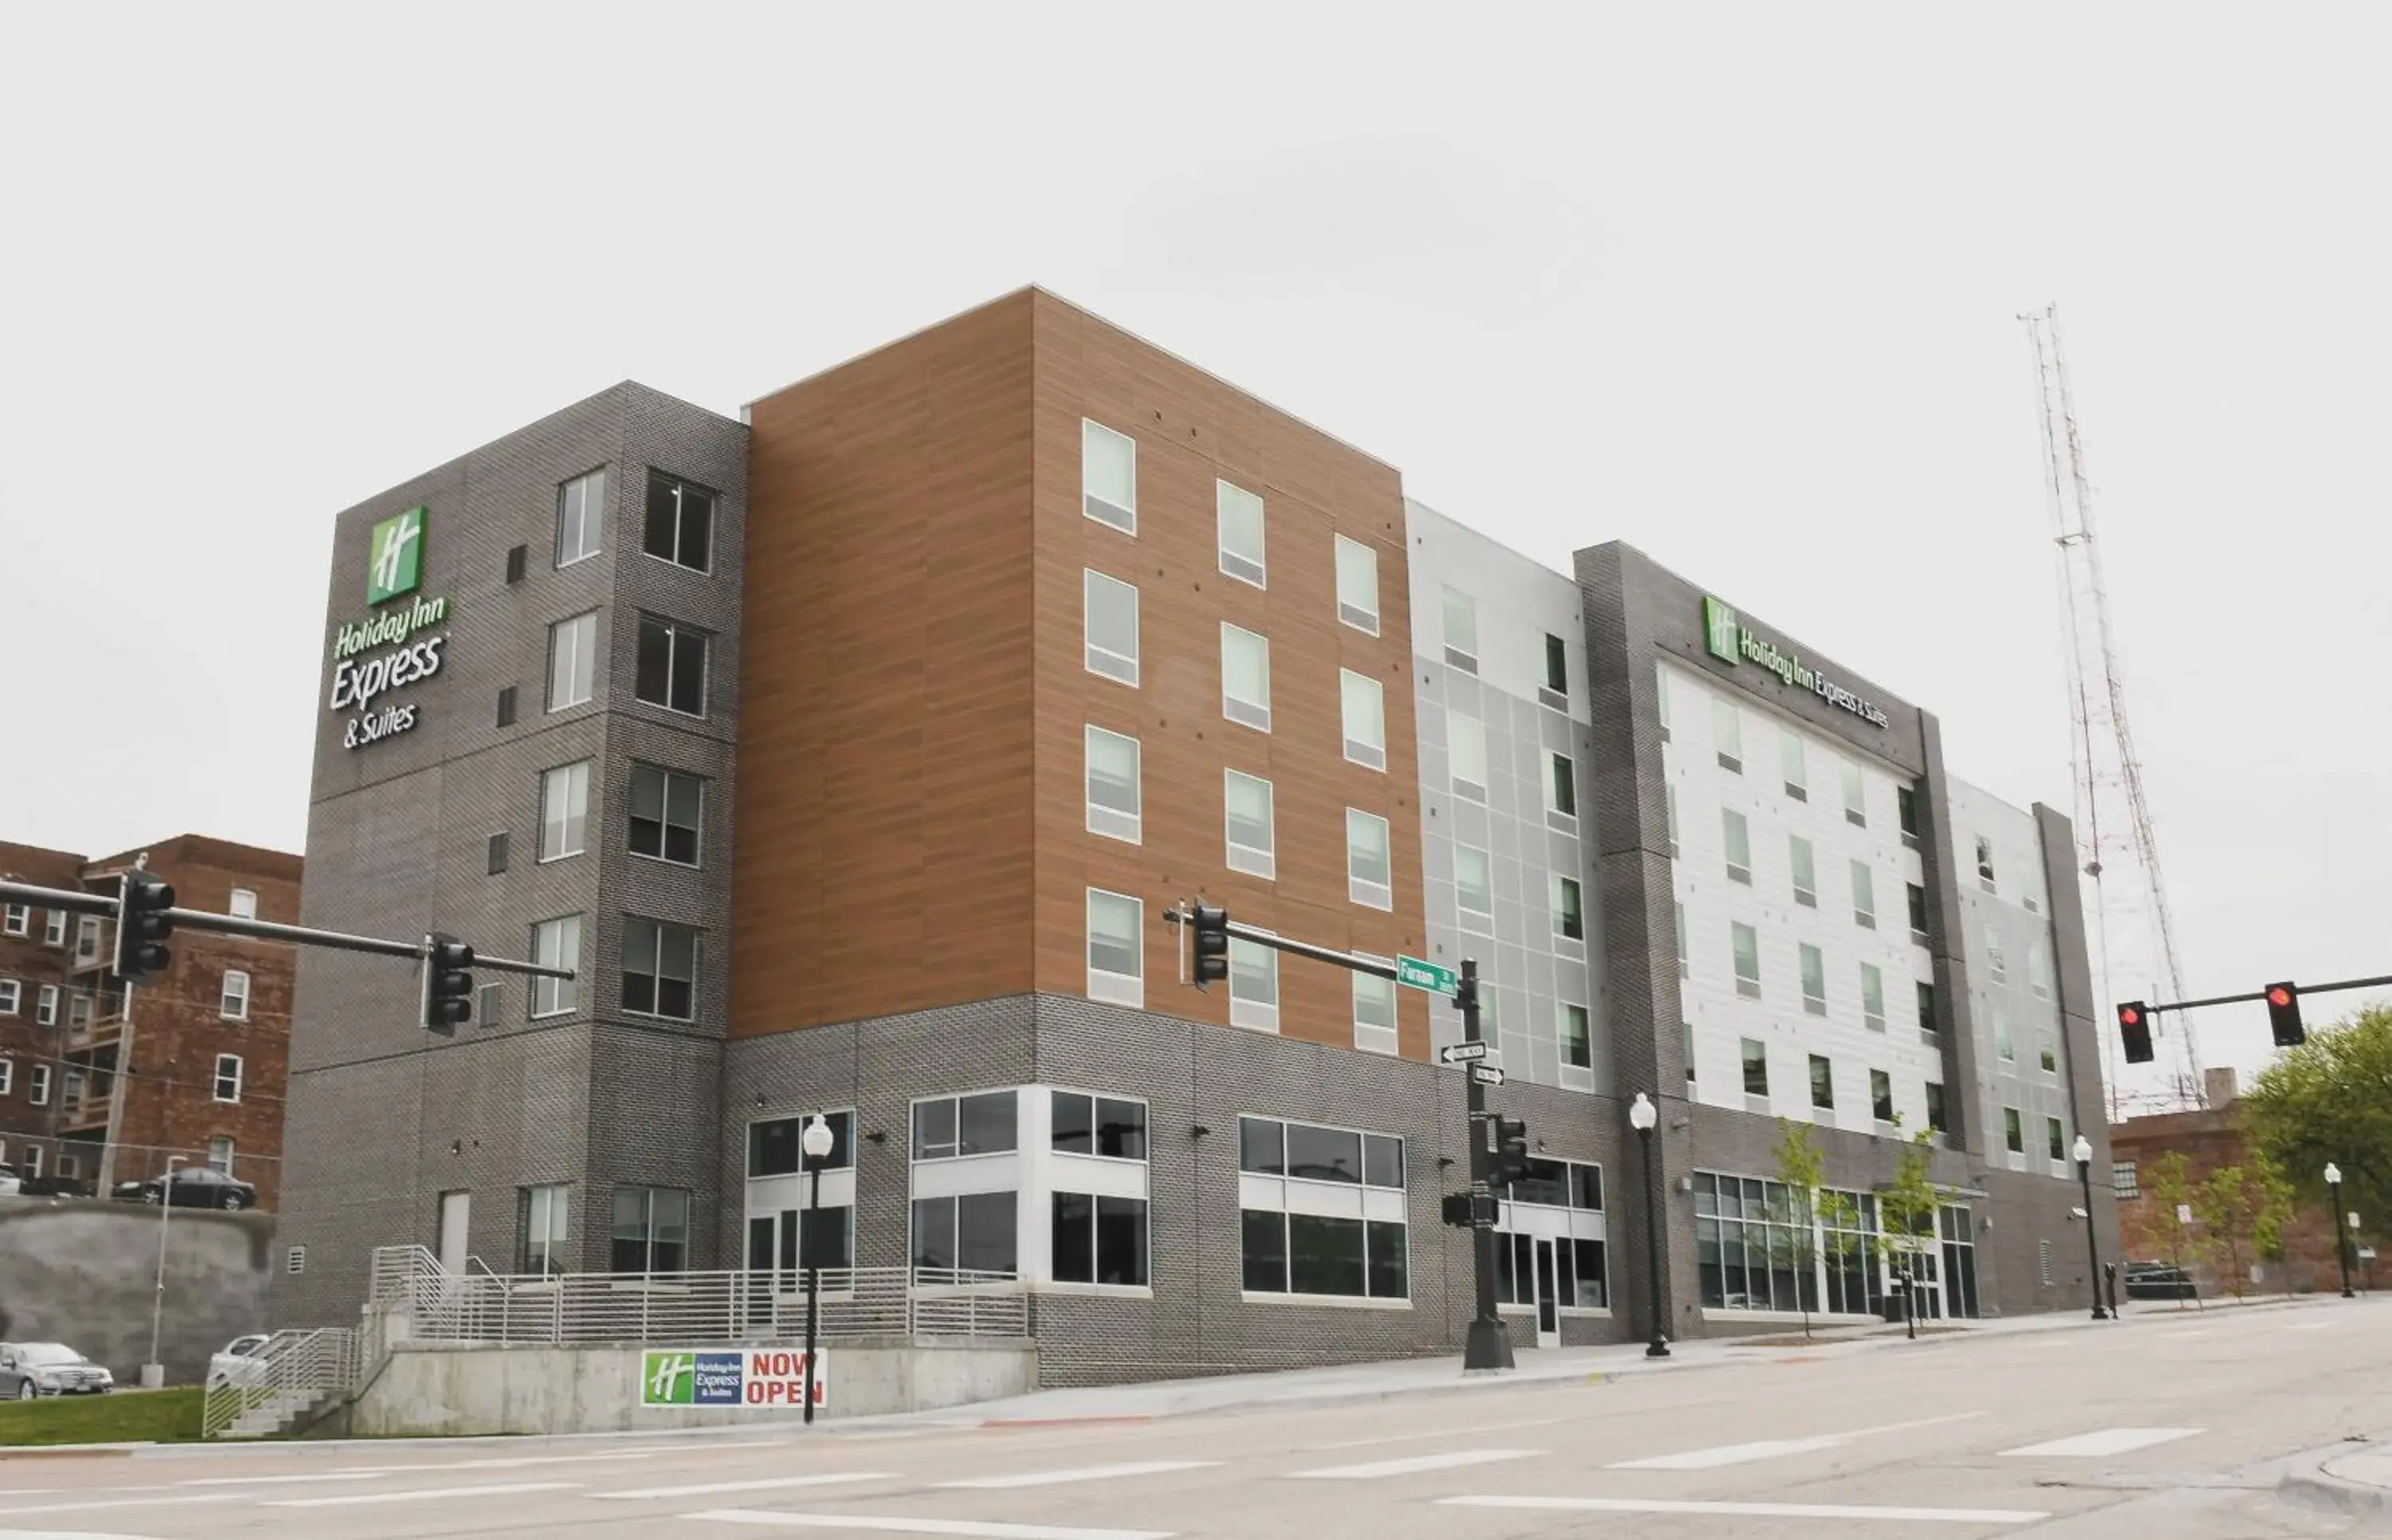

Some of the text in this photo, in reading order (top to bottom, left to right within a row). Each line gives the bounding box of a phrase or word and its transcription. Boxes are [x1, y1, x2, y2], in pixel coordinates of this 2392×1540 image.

[334, 595, 444, 659] Holiday Inn
[330, 637, 443, 711] Express
[1741, 627, 1792, 685] Holiday
[1793, 654, 1814, 690] Inn
[1815, 670, 1857, 712] Express
[344, 705, 415, 748] & Suites
[696, 1373, 740, 1390] Express
[753, 1352, 817, 1377] NOW
[747, 1381, 823, 1404] OPEN
